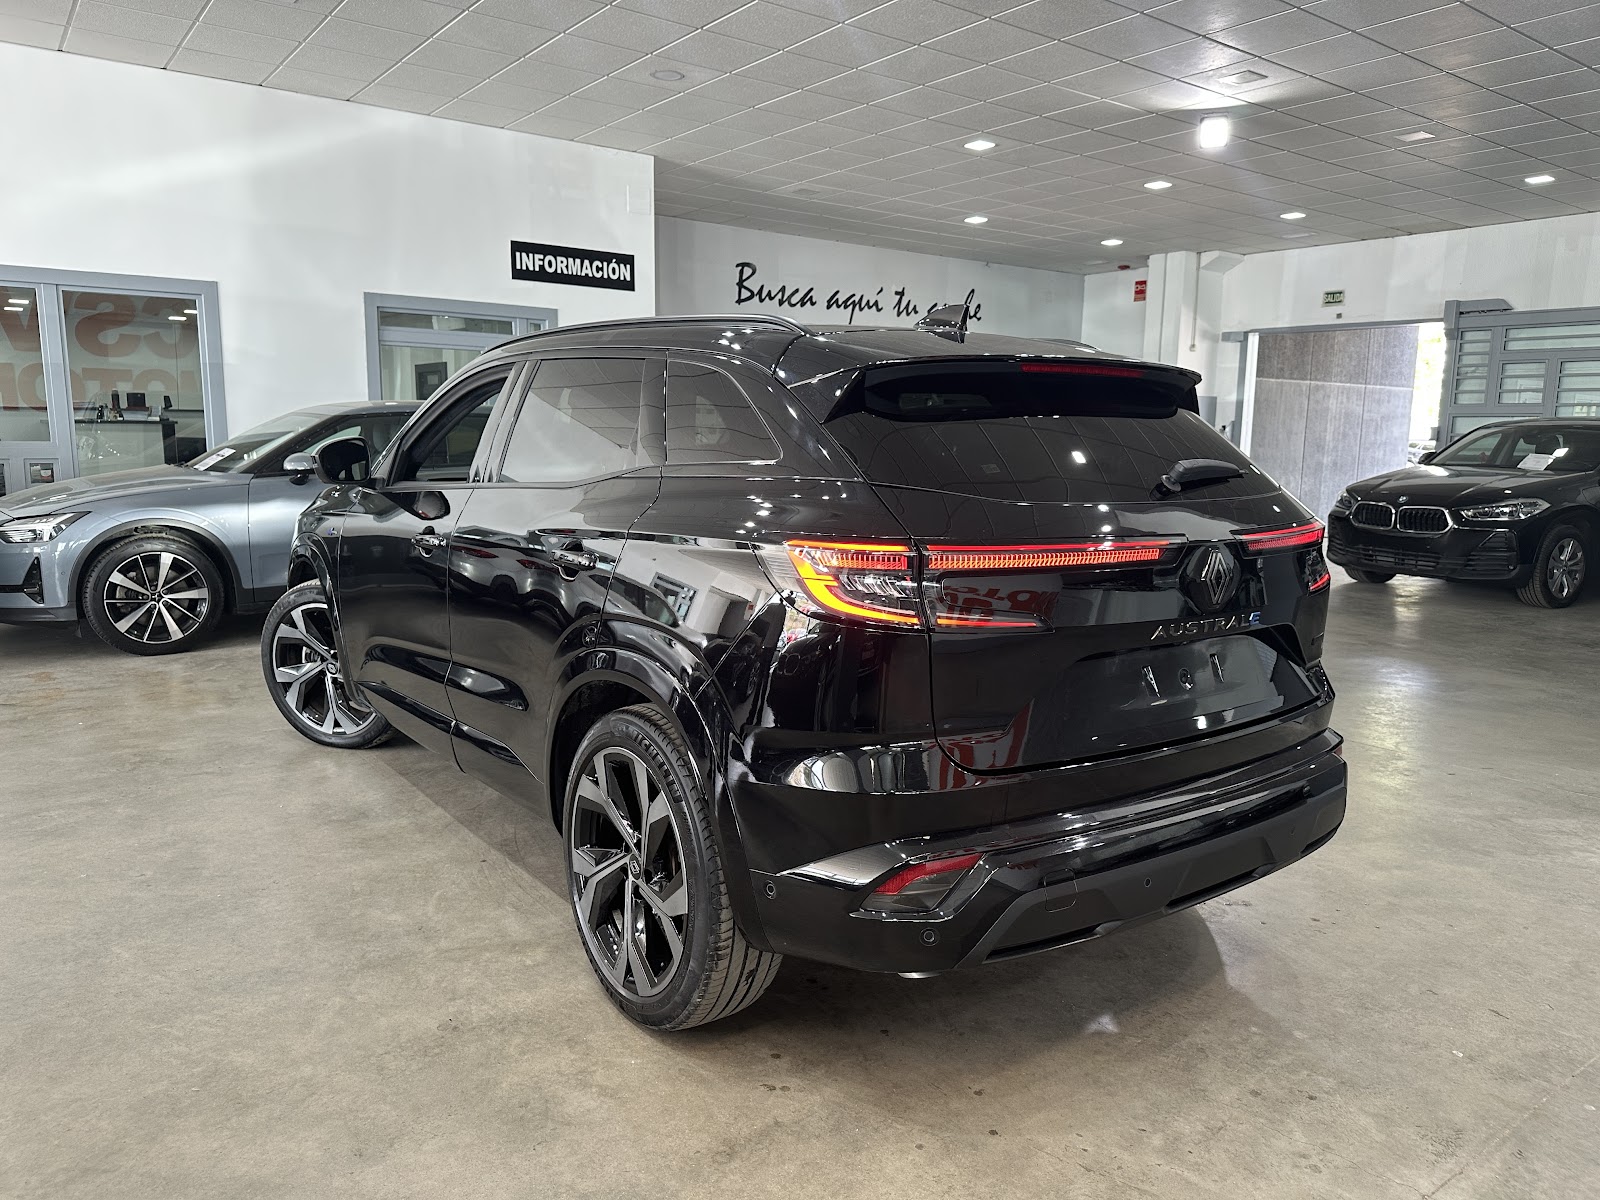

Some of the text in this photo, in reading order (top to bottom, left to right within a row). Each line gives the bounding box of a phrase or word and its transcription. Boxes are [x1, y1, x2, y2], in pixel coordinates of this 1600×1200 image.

[515, 251, 631, 282] INFORMACIÓN
[735, 262, 817, 308] Busca
[826, 287, 883, 325] aquí
[893, 287, 919, 317] tu
[1324, 292, 1344, 303] SALIDA
